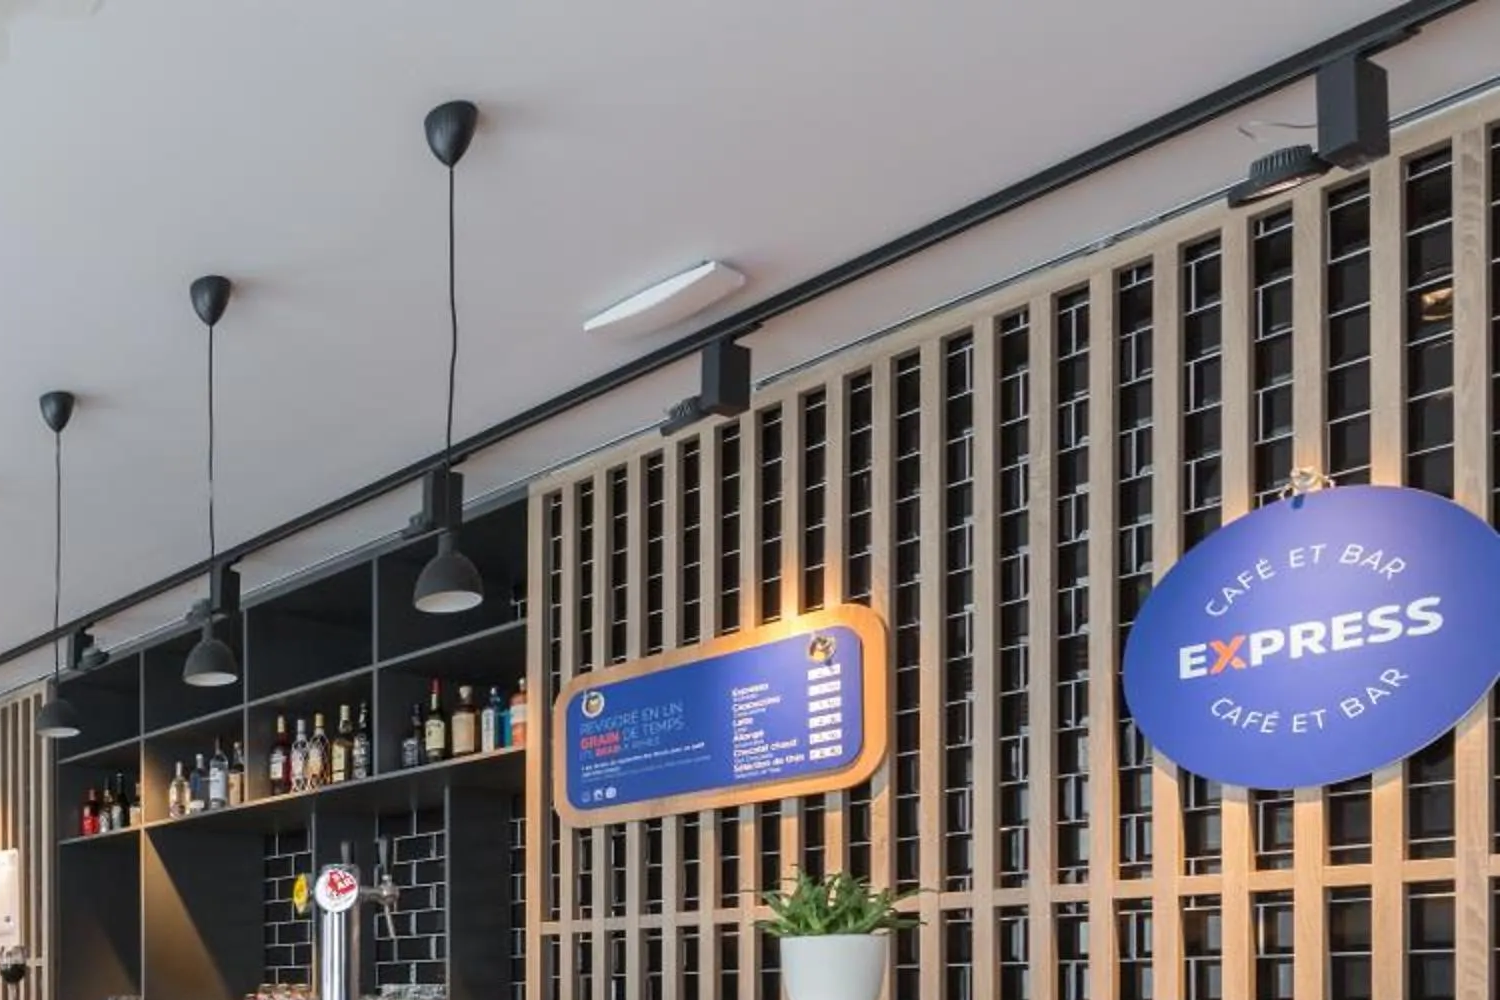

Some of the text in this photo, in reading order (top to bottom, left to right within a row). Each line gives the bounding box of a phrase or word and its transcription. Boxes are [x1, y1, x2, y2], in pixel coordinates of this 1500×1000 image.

[1205, 543, 1407, 616] CAFÉ ET BAR
[1179, 596, 1444, 679] EXPRESS
[1210, 667, 1409, 733] CAFÉ ET BAR
